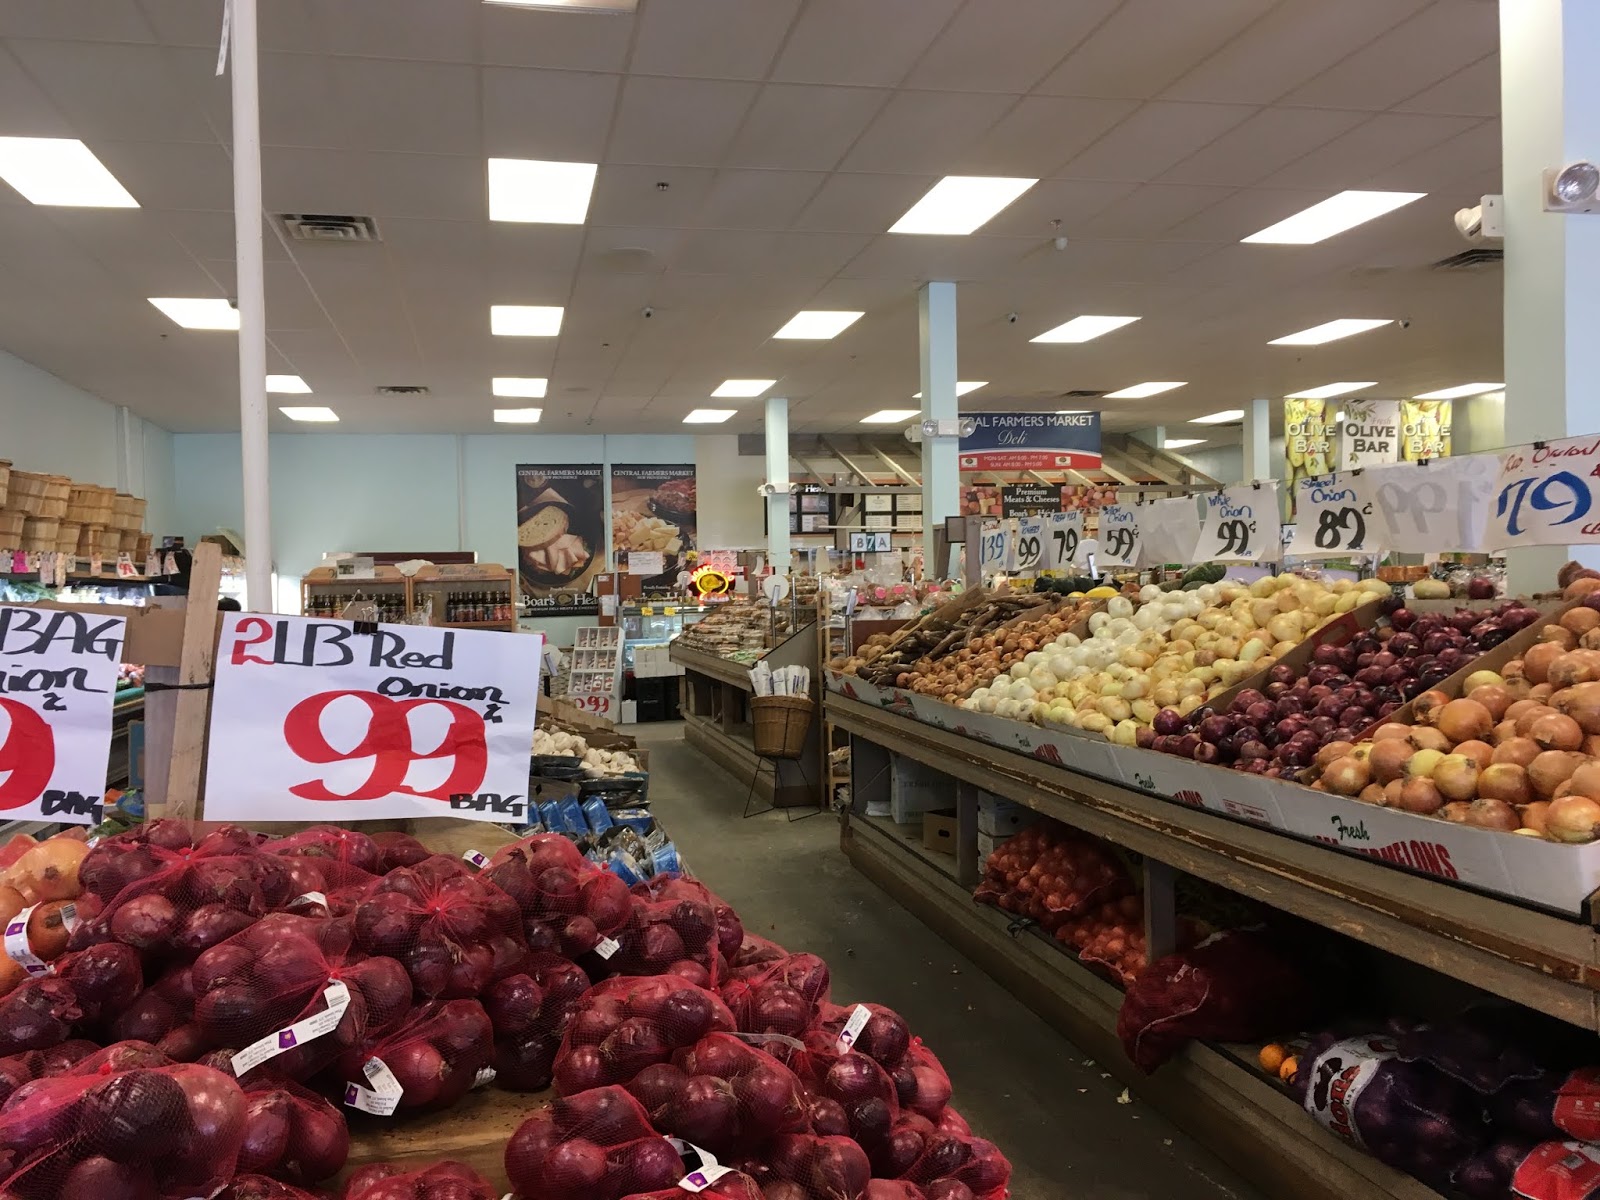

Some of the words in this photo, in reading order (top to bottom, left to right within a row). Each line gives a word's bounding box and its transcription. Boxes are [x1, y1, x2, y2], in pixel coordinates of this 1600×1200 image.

[992, 416, 1044, 427] FARMERS
[1047, 415, 1094, 426] MARKET
[1288, 423, 1337, 436] OLIVE
[1345, 423, 1396, 437] OLIVE
[1403, 424, 1451, 436] OLIVE
[997, 430, 1028, 445] Deli
[1295, 439, 1330, 453] BAR
[1353, 439, 1389, 453] BAR
[1411, 439, 1446, 453] BAR
[1015, 487, 1048, 496] Premium
[1311, 489, 1357, 503] Onion
[1003, 495, 1025, 503] Meats
[1025, 495, 1033, 503] &
[1033, 495, 1060, 503] Cheeses
[1496, 470, 1593, 536] 79
[1220, 506, 1252, 518] Onion
[1018, 536, 1041, 566] 99
[1053, 527, 1079, 564] 79
[521, 593, 556, 607] Boar's
[369, 630, 455, 670] Red
[377, 676, 510, 704] Onion
[283, 689, 489, 802] 99
[449, 793, 527, 817] BAG
[1330, 815, 1371, 841] Fresh
